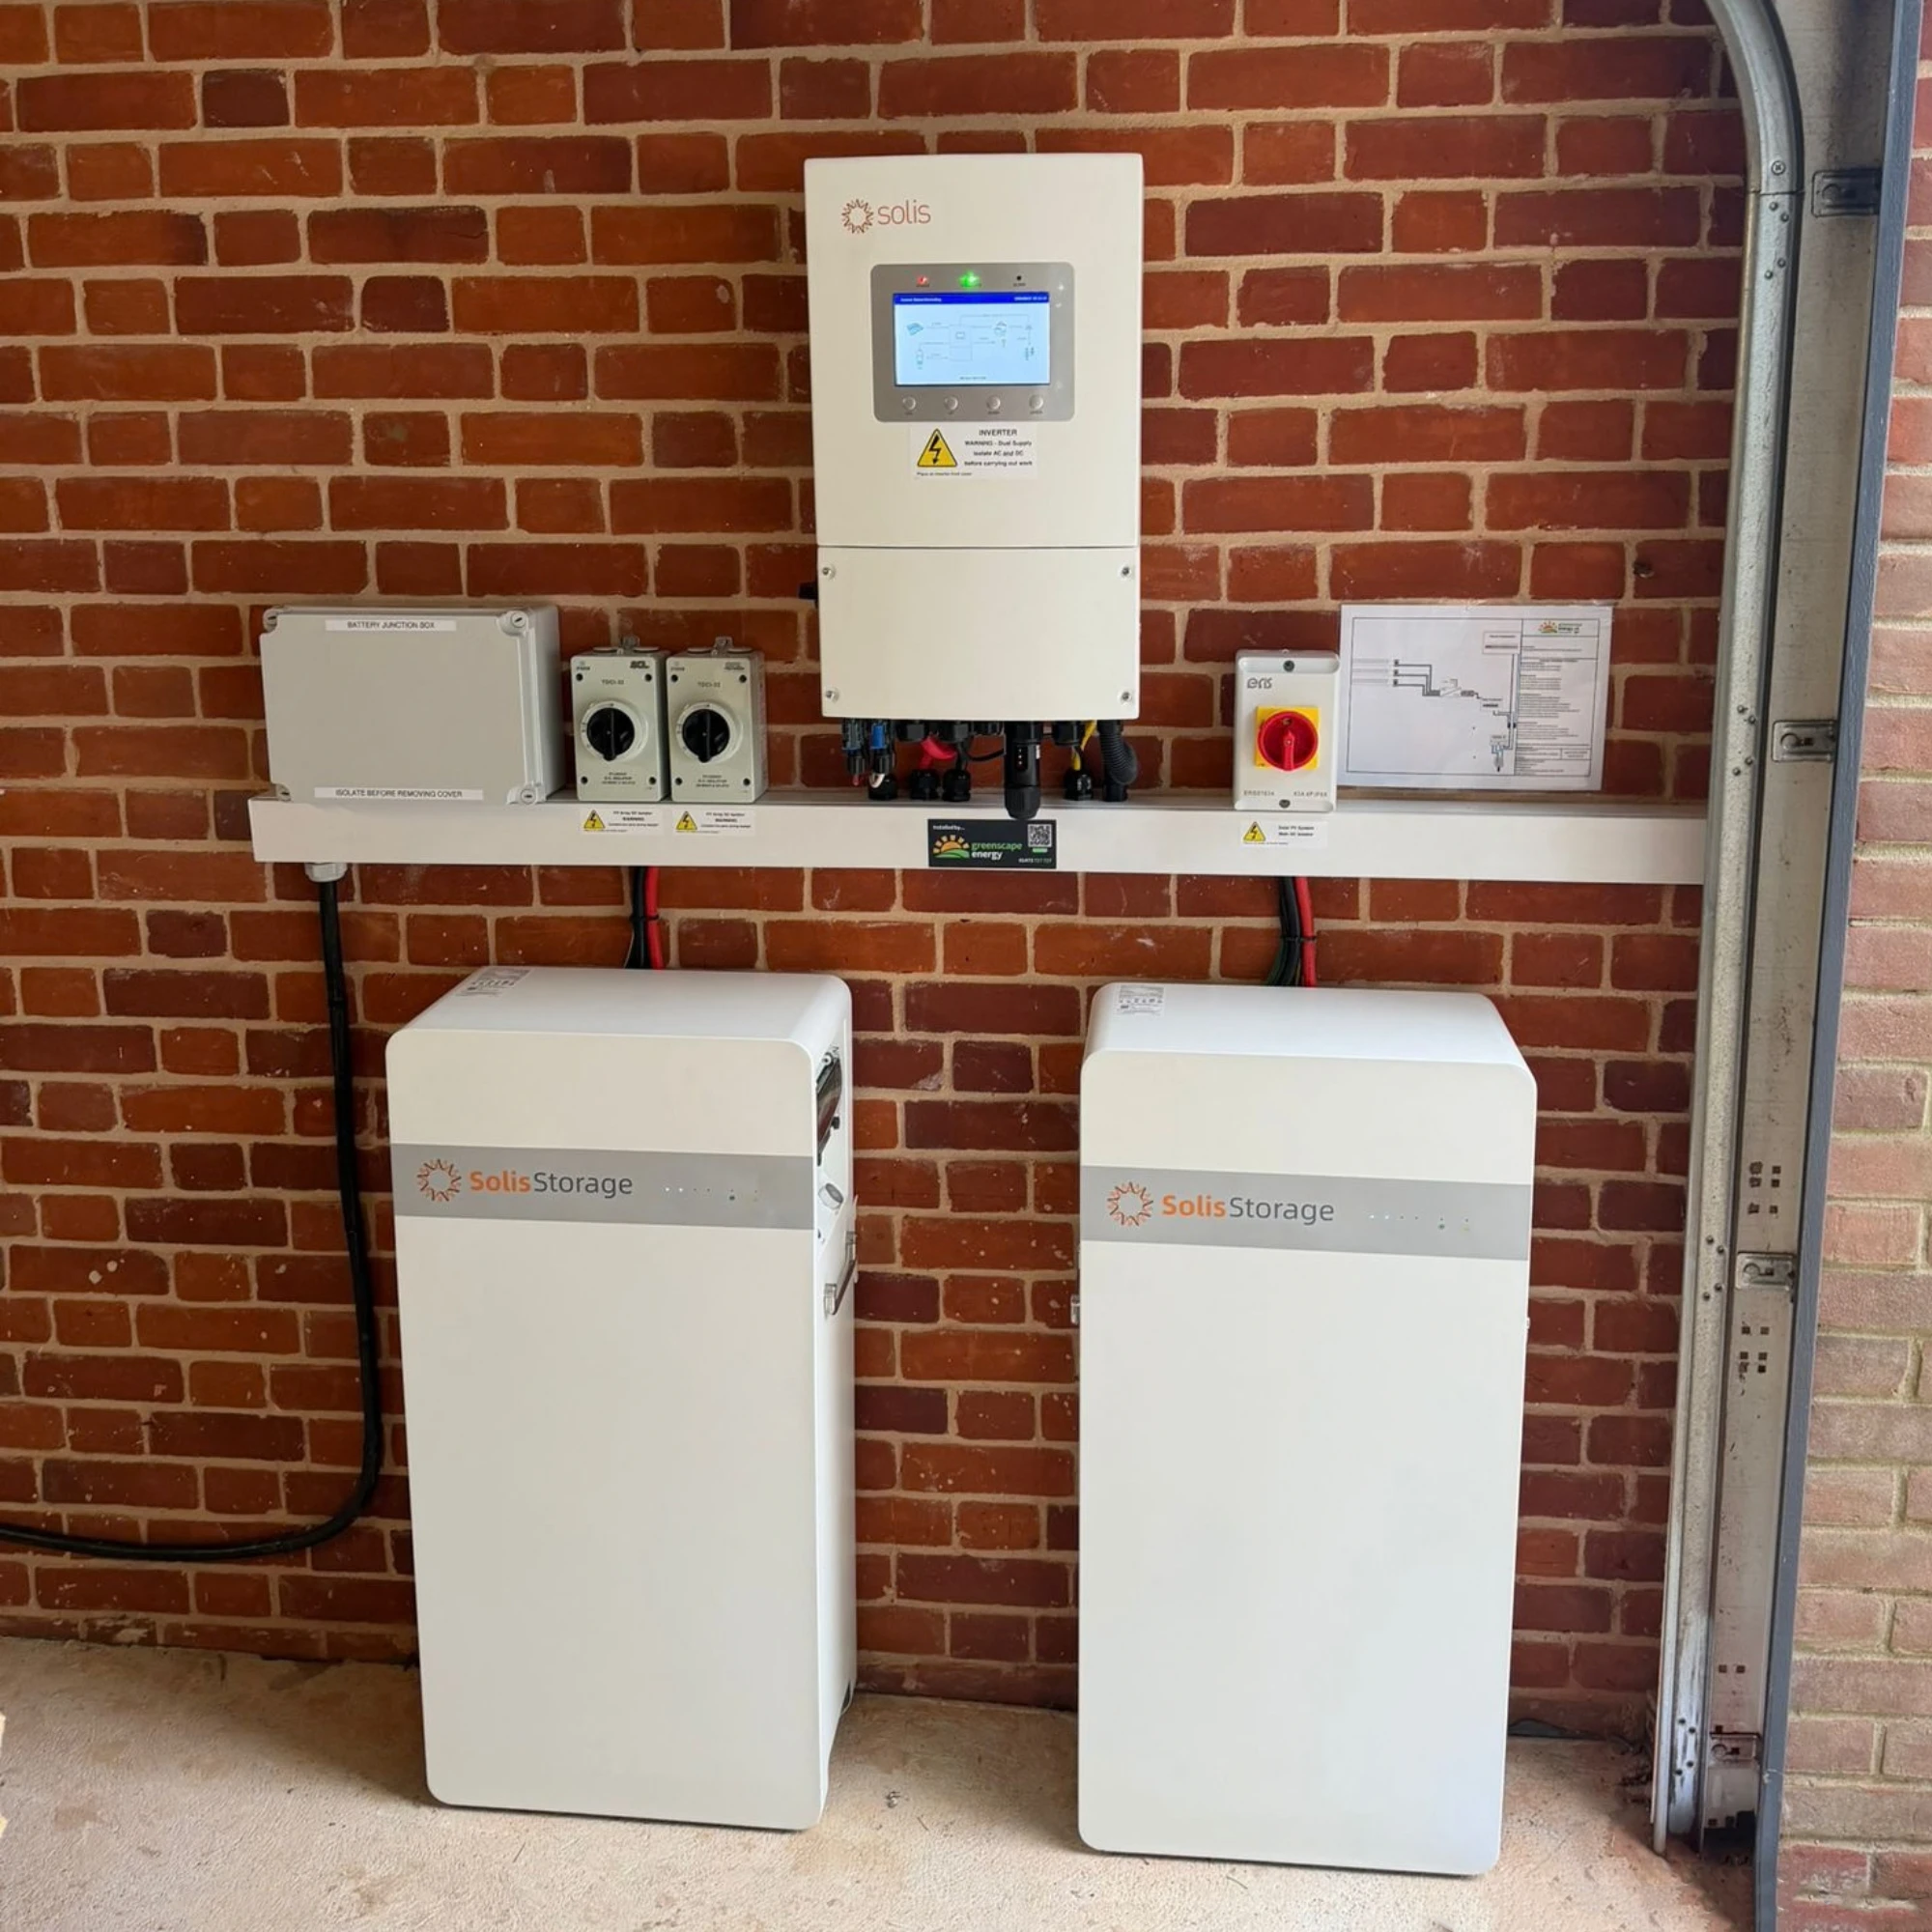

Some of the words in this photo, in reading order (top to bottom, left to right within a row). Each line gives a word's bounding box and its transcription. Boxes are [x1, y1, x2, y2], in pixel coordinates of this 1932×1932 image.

[877, 199, 931, 225] solis
[347, 620, 380, 629] BATTERY
[397, 789, 436, 798] REMOVING
[972, 842, 1022, 852] greenscape
[972, 851, 1003, 861] energy
